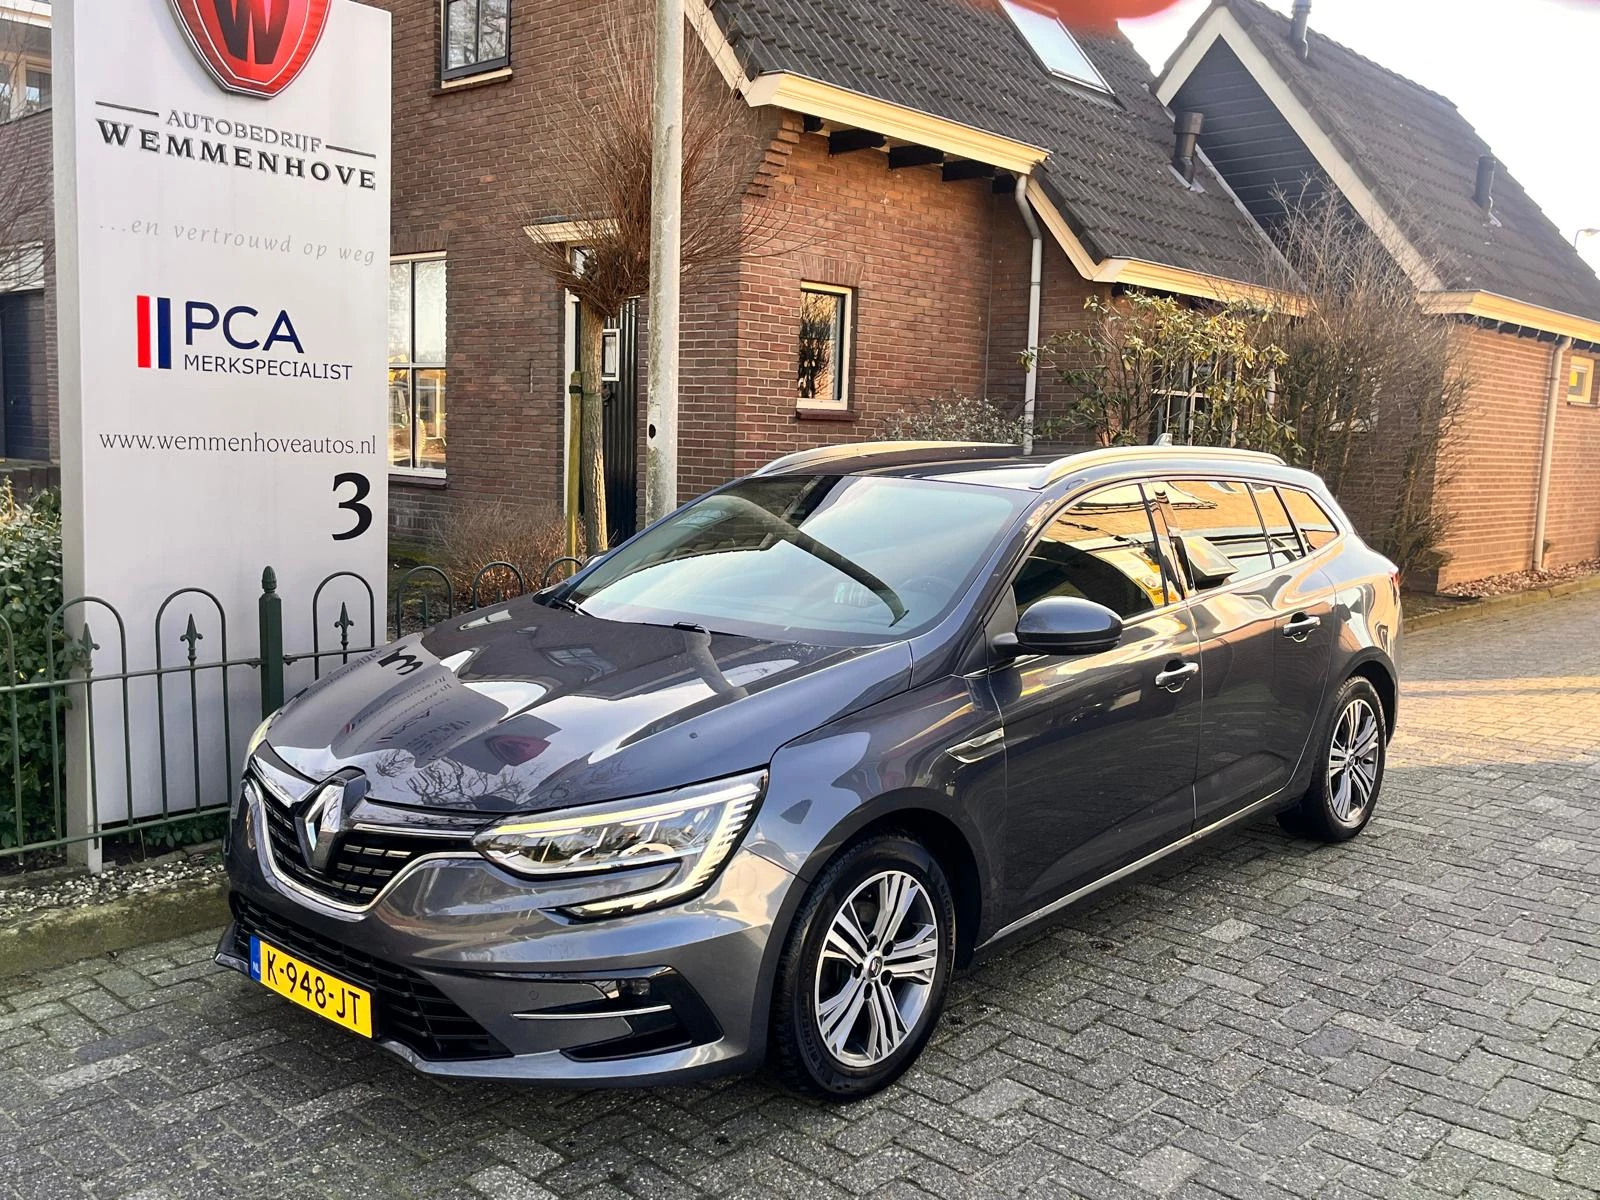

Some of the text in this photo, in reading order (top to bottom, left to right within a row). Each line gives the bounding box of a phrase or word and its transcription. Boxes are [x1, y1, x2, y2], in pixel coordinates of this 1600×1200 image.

[96, 117, 377, 191] WEMMENHOVE
[165, 108, 322, 154] AUTOBEDRIJF
[174, 225, 293, 254] vertrouwd
[303, 242, 328, 259] op
[338, 245, 376, 266] weg
[185, 300, 305, 354] PCA
[184, 354, 353, 381] MERKSPECIALIST
[99, 431, 377, 455] www.wemmenhoveautos.nl
[331, 471, 373, 541] 3
[252, 960, 260, 974] NL
[267, 950, 361, 1024] K-948-JT
